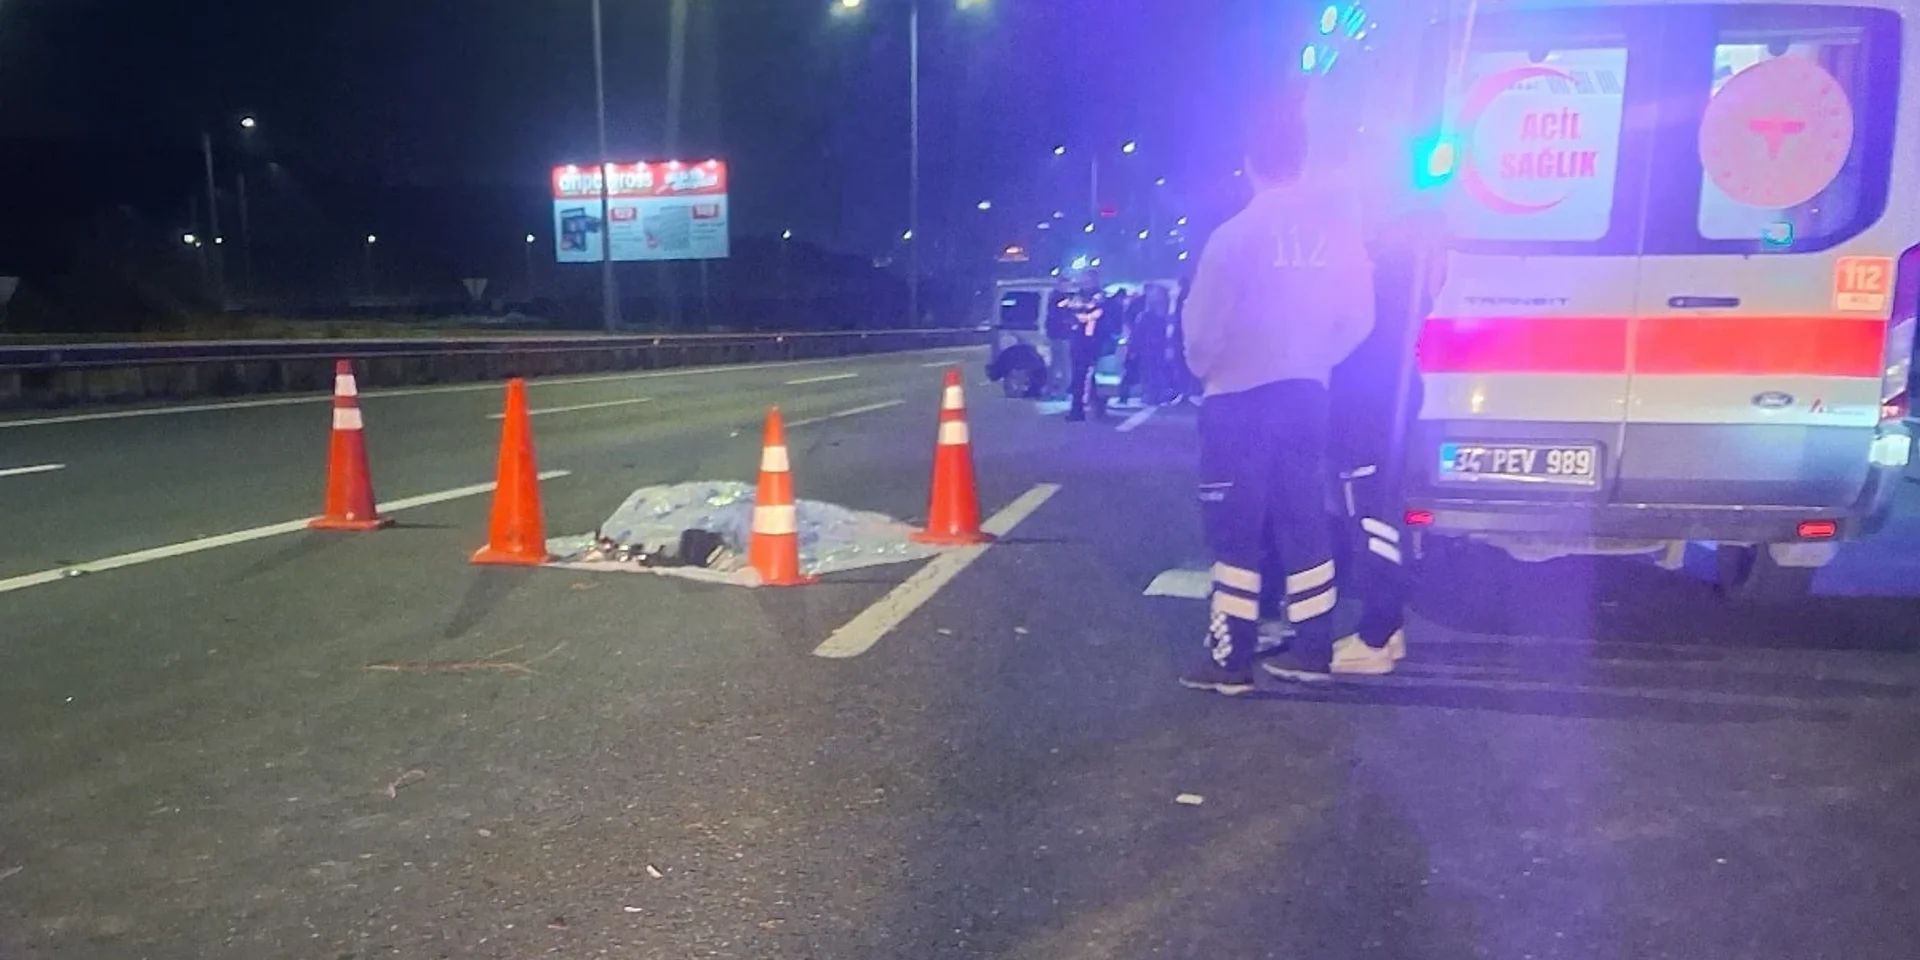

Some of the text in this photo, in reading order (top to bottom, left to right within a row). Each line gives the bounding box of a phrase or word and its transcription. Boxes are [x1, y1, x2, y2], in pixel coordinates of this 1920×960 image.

[1521, 107, 1580, 140] ACİL
[1502, 147, 1598, 179] SAĞLIK
[1270, 224, 1327, 268] 112
[1845, 260, 1882, 290] 112
[1492, 448, 1537, 473] PEV
[1547, 449, 1590, 474] 989
